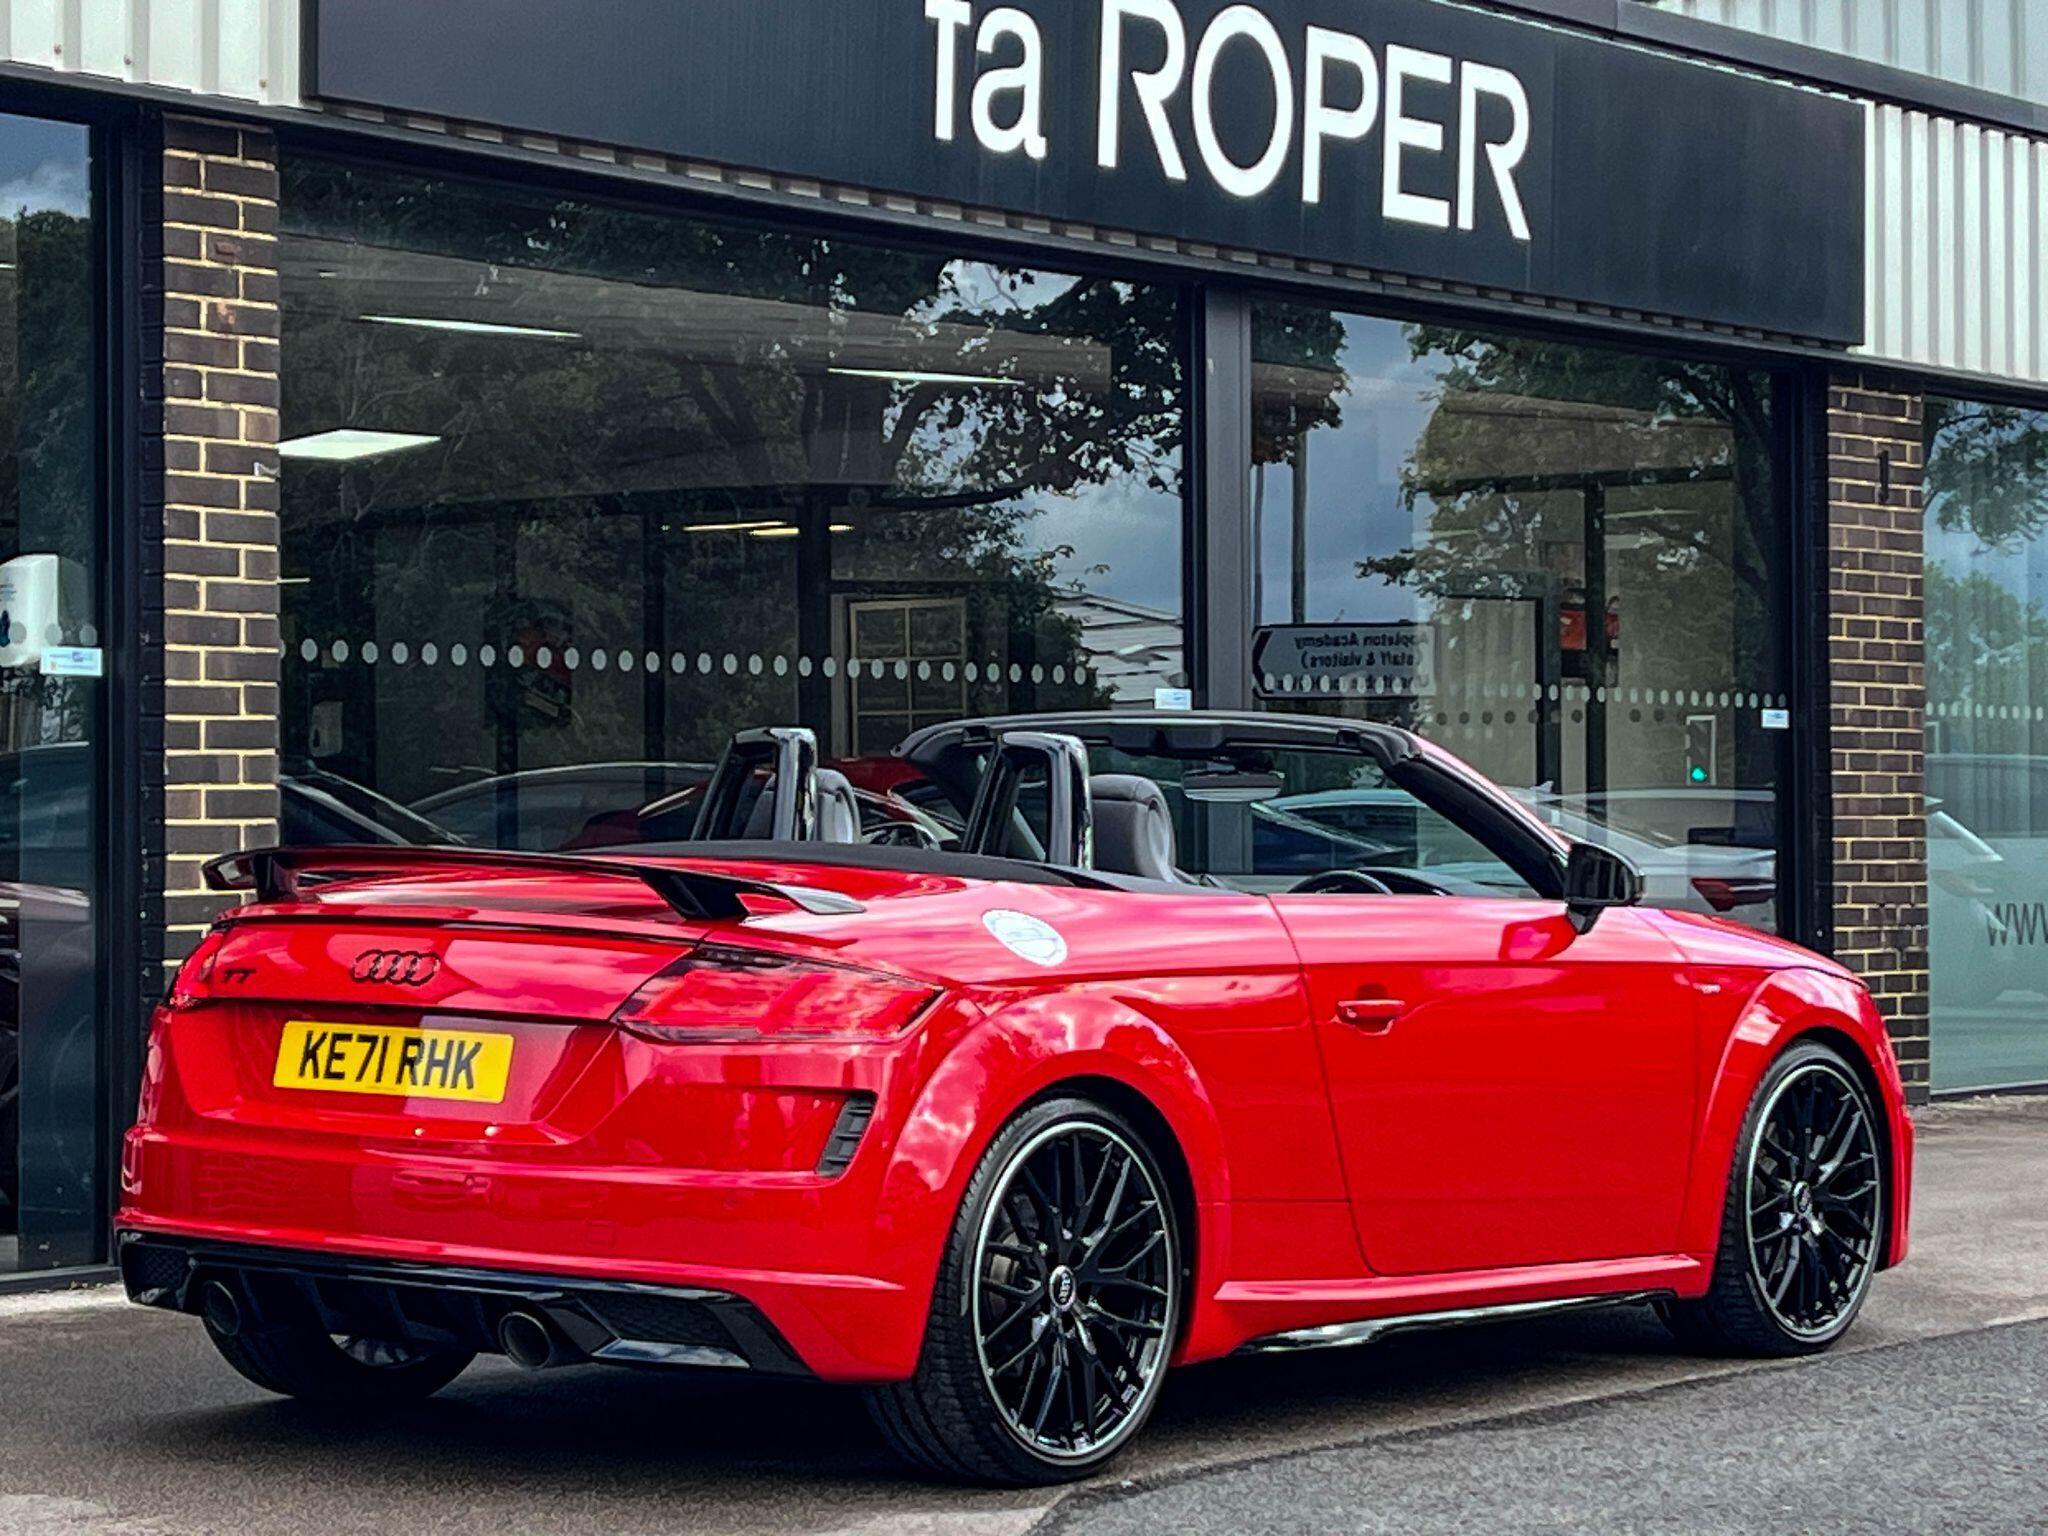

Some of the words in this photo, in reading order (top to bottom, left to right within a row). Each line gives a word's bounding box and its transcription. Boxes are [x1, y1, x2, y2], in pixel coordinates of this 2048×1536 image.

[1098, 0, 1532, 241] ROPER
[298, 1029, 391, 1083] KE71
[395, 1035, 483, 1090] RHK
